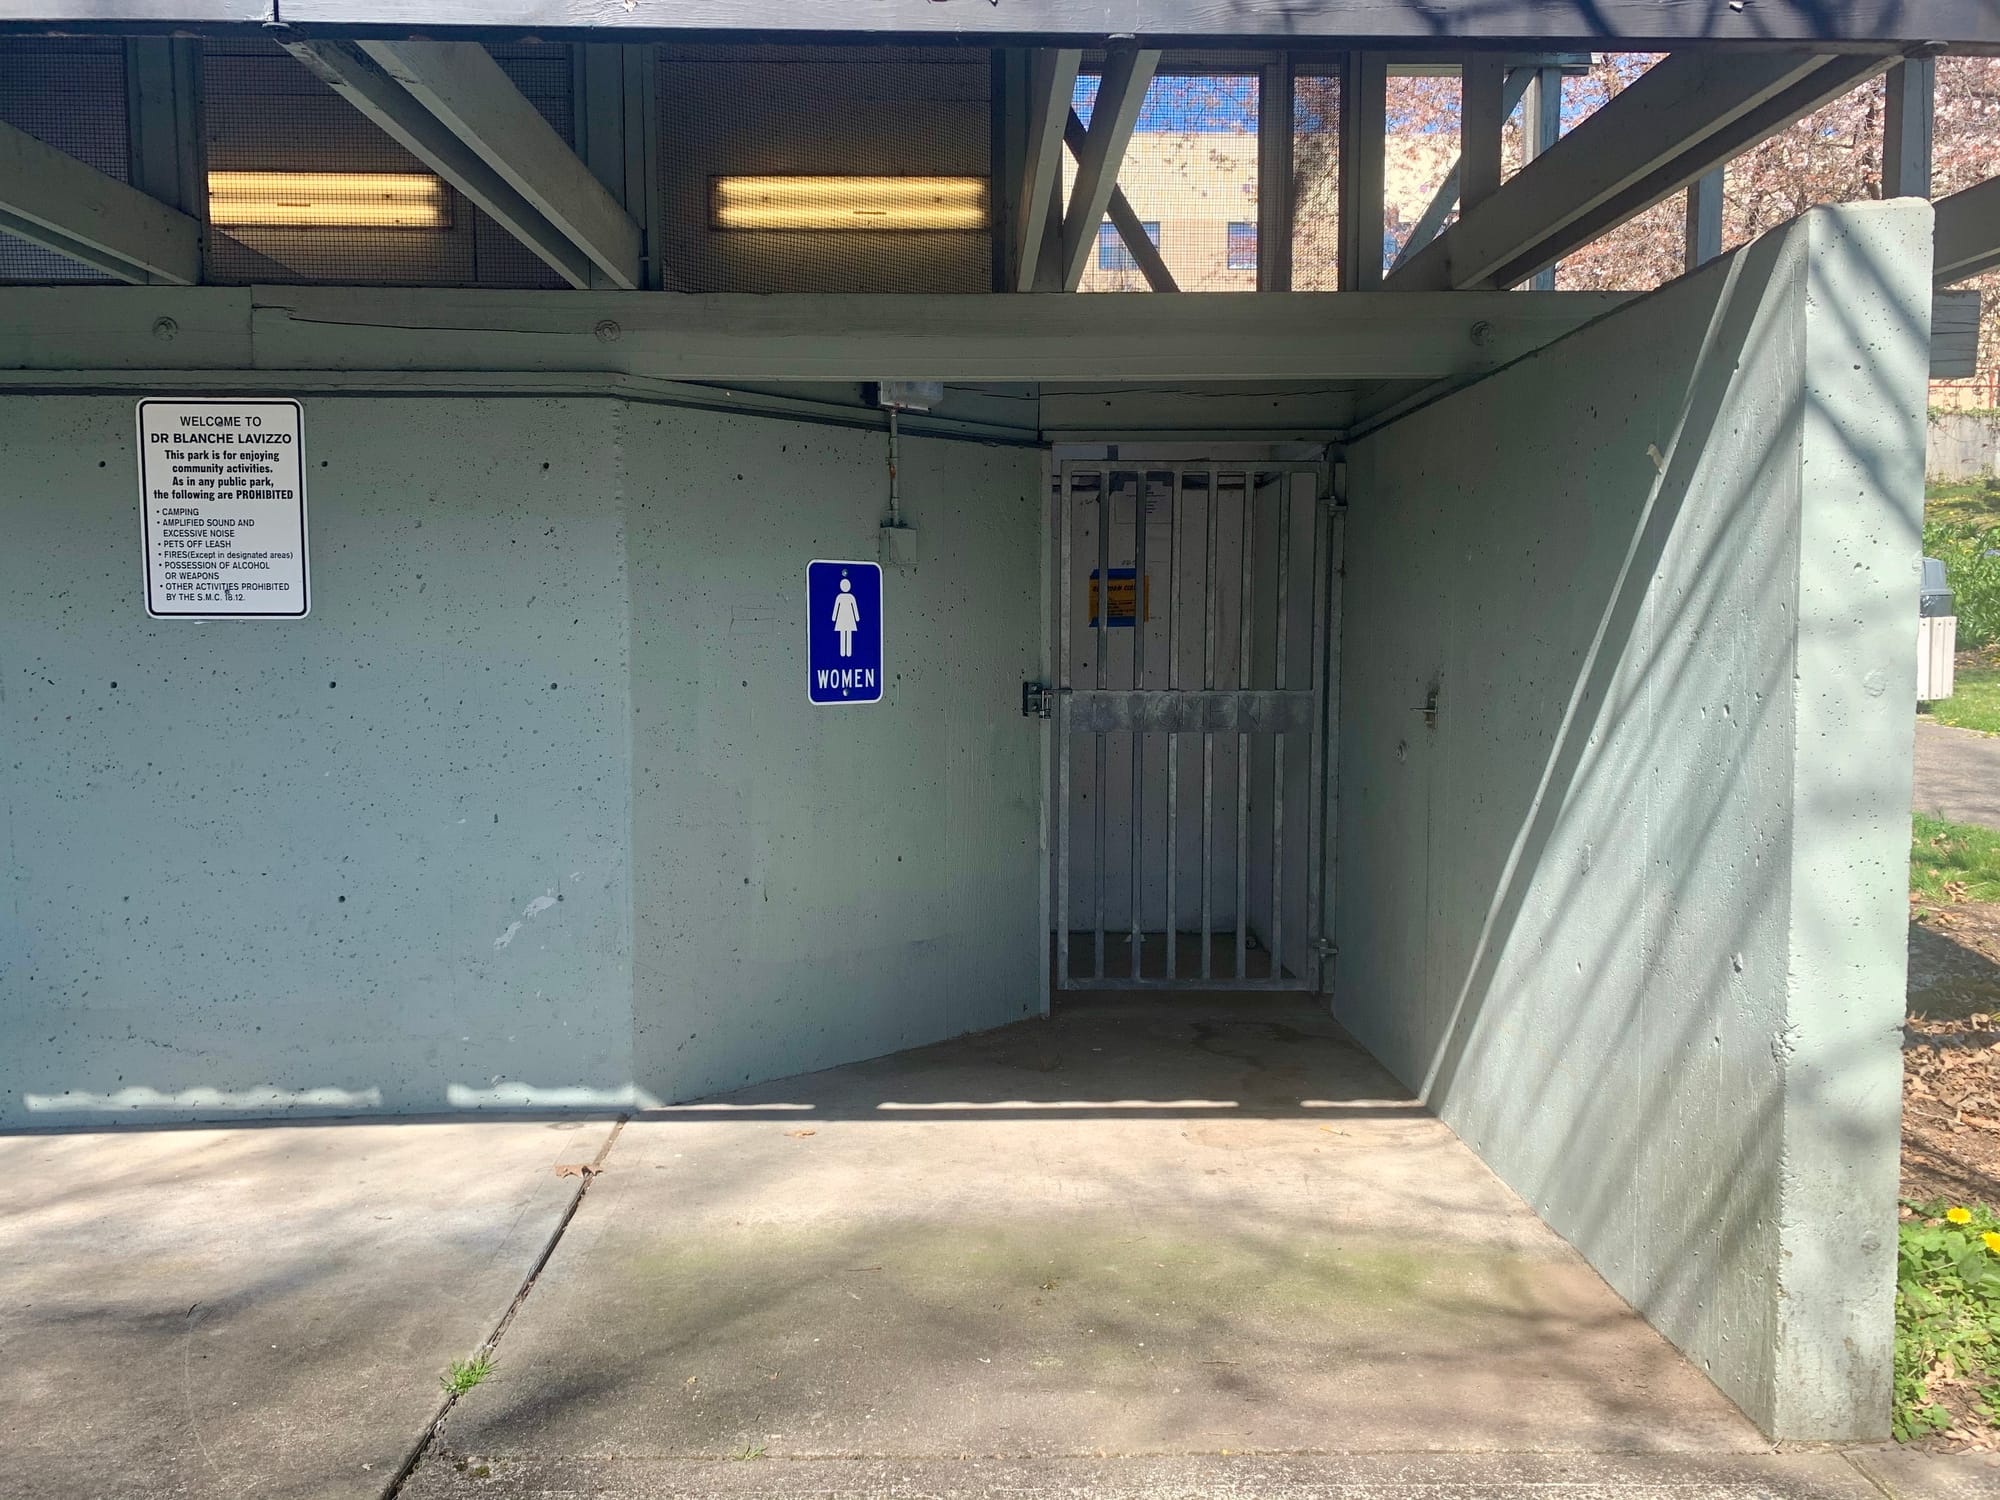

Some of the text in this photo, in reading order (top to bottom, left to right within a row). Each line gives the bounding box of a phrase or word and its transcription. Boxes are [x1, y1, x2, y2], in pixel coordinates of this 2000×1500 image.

[180, 416, 262, 427] WELCOME TO
[151, 433, 292, 444] DR BLANCHE LAVIZZO
[164, 450, 280, 462] This park is for enjoying
[172, 463, 273, 475] community activities.
[172, 476, 274, 488] As in any public park,
[153, 489, 169, 499] the
[172, 489, 215, 501] following
[236, 490, 293, 499] PROHIBITED
[162, 508, 199, 516] CAMPING
[163, 529, 208, 537] EXCESSIVE
[164, 540, 231, 548] PETS OFF LEASH
[164, 550, 216, 559] FIRES(Except
[226, 551, 268, 560] designated
[164, 561, 217, 569] POSSESSION
[232, 561, 270, 570] ALCOHOL
[179, 572, 219, 580] WEAPONS
[197, 593, 222, 601] S.M.C.
[817, 668, 874, 688] WOMEN
